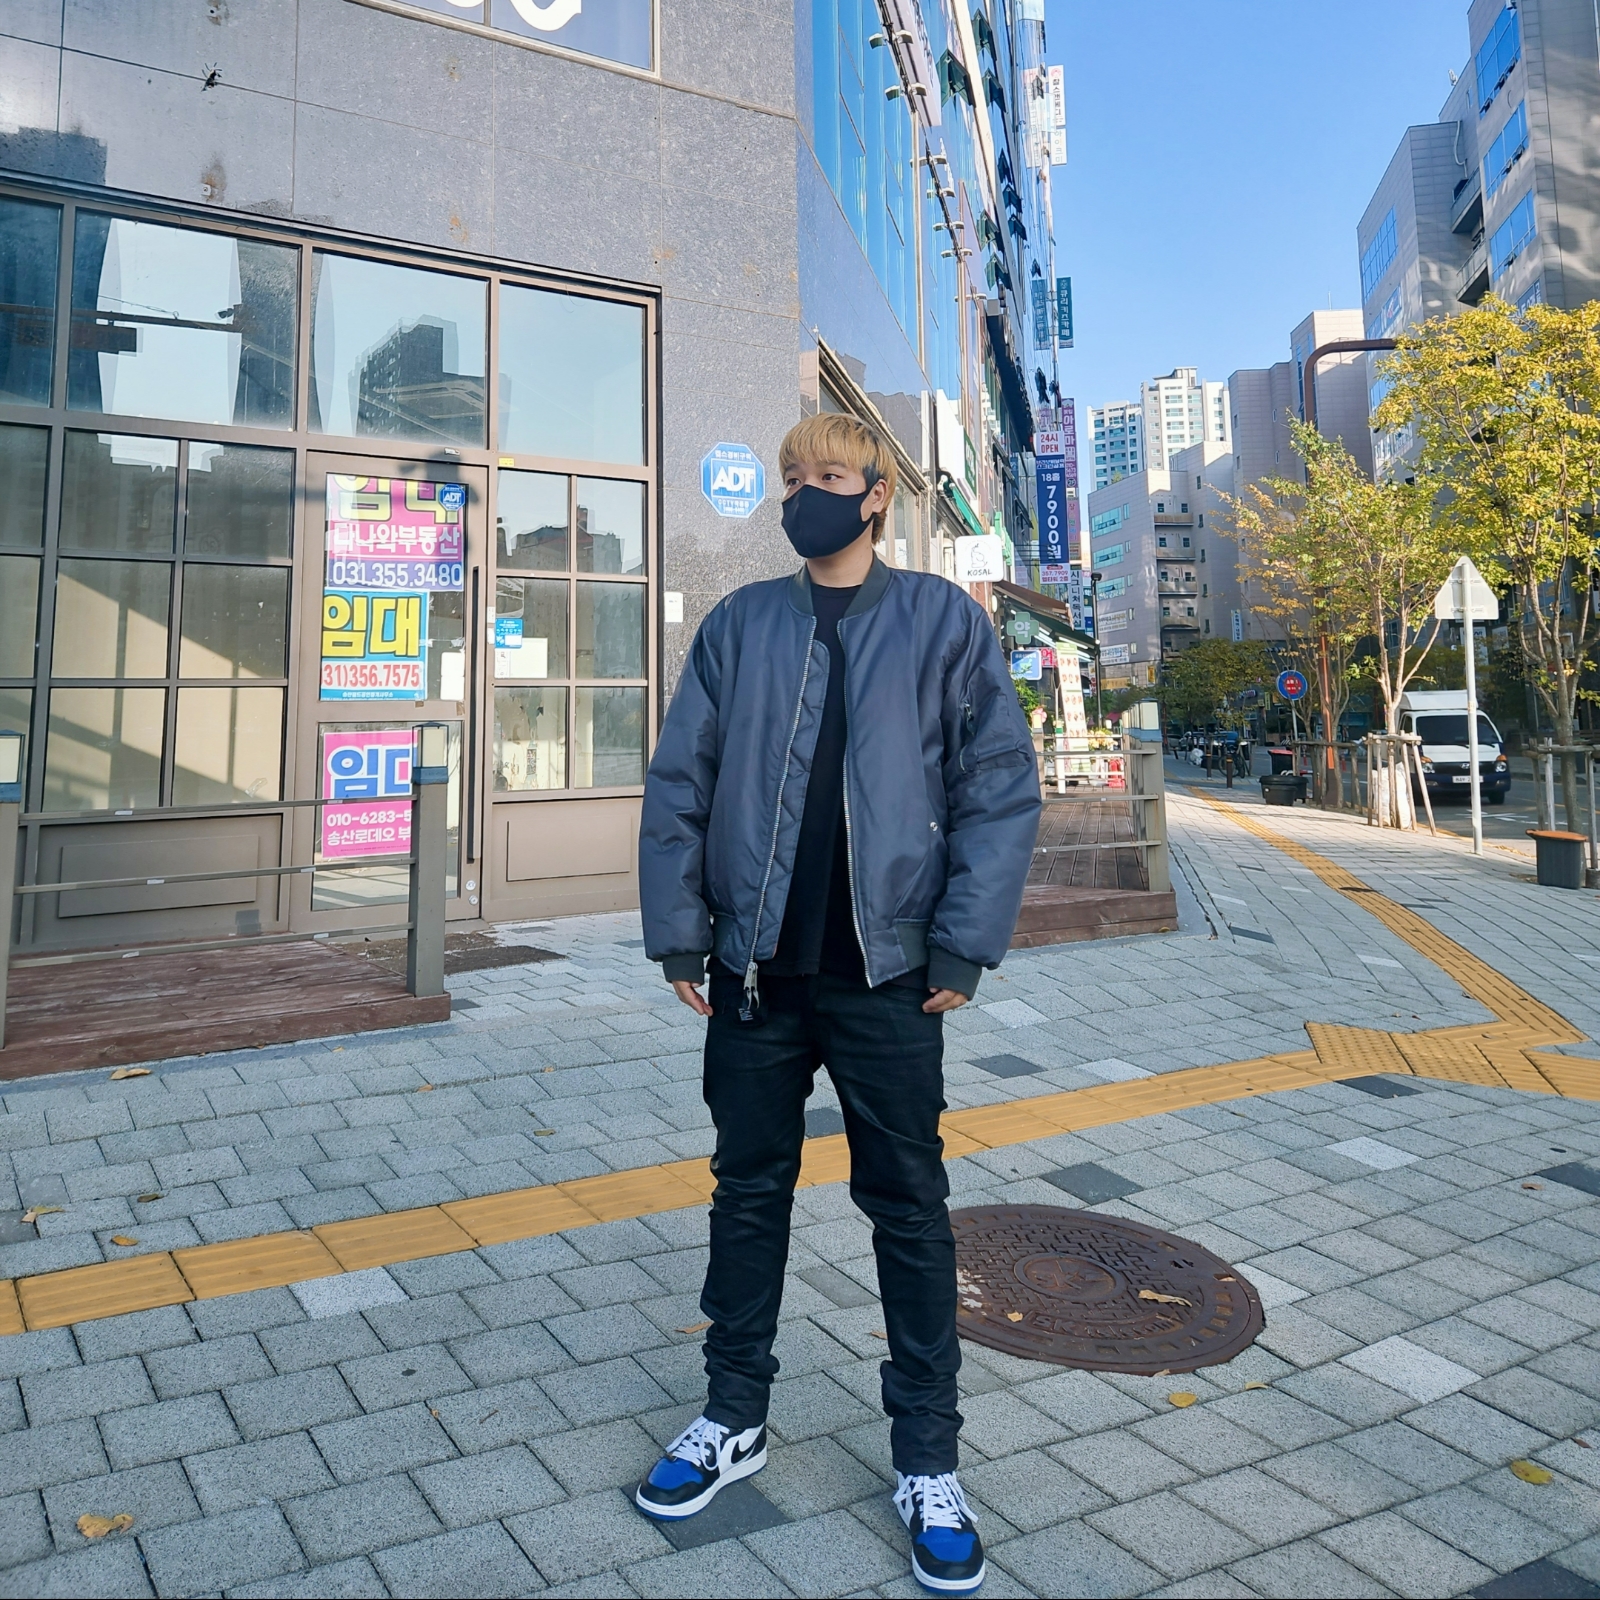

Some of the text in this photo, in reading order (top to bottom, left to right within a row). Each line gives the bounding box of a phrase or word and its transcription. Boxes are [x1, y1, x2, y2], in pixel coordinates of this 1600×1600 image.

[1040, 433, 1059, 443] 24시
[1063, 415, 1075, 446] 아로마
[1040, 444, 1059, 454] OPEN
[713, 466, 755, 493] ADT
[443, 492, 462, 503] ADT
[332, 560, 462, 588] 031.355.3480
[967, 568, 993, 577] KOSAL
[1070, 570, 1082, 628] 시그니처독서실
[322, 594, 421, 658] 임대
[1014, 621, 1031, 638] 약
[321, 663, 420, 688] 31)356.7575
[327, 827, 395, 846] 송산로데오
[1032, 1314, 1076, 1335] SK
